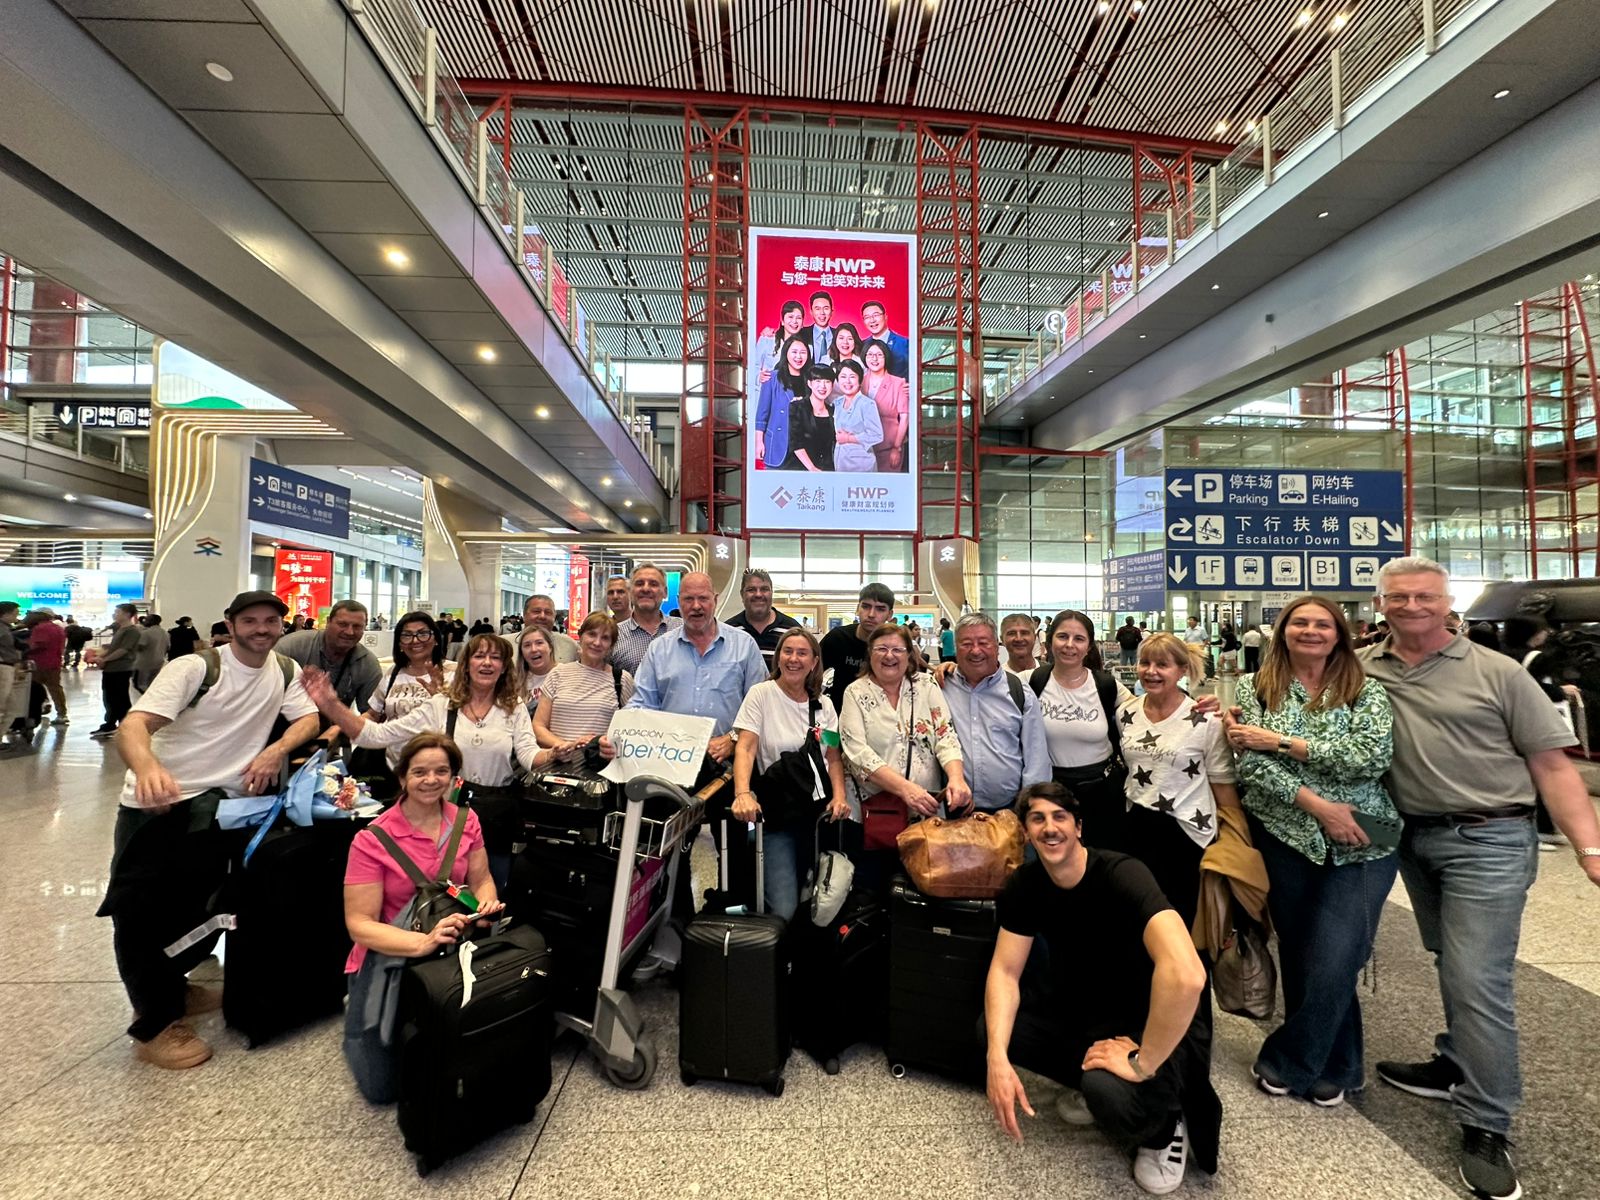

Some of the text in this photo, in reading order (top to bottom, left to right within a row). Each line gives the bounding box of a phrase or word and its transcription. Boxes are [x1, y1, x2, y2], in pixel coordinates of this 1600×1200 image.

[781, 271, 886, 289] 与您一起笑对未来
[1229, 474, 1272, 489] 停车场
[1312, 475, 1354, 490] 网约车
[797, 486, 825, 504] 泰康
[847, 487, 889, 499] HWP
[1228, 493, 1269, 506] Parking
[1312, 494, 1359, 507] E-Hailing
[797, 503, 826, 512] Taikang
[1235, 516, 1340, 532] 下行扶梯
[1236, 534, 1340, 545] Escalator Down
[1201, 560, 1220, 574] 1F
[1317, 561, 1336, 574] B1
[16, 591, 69, 599] WELCOME
